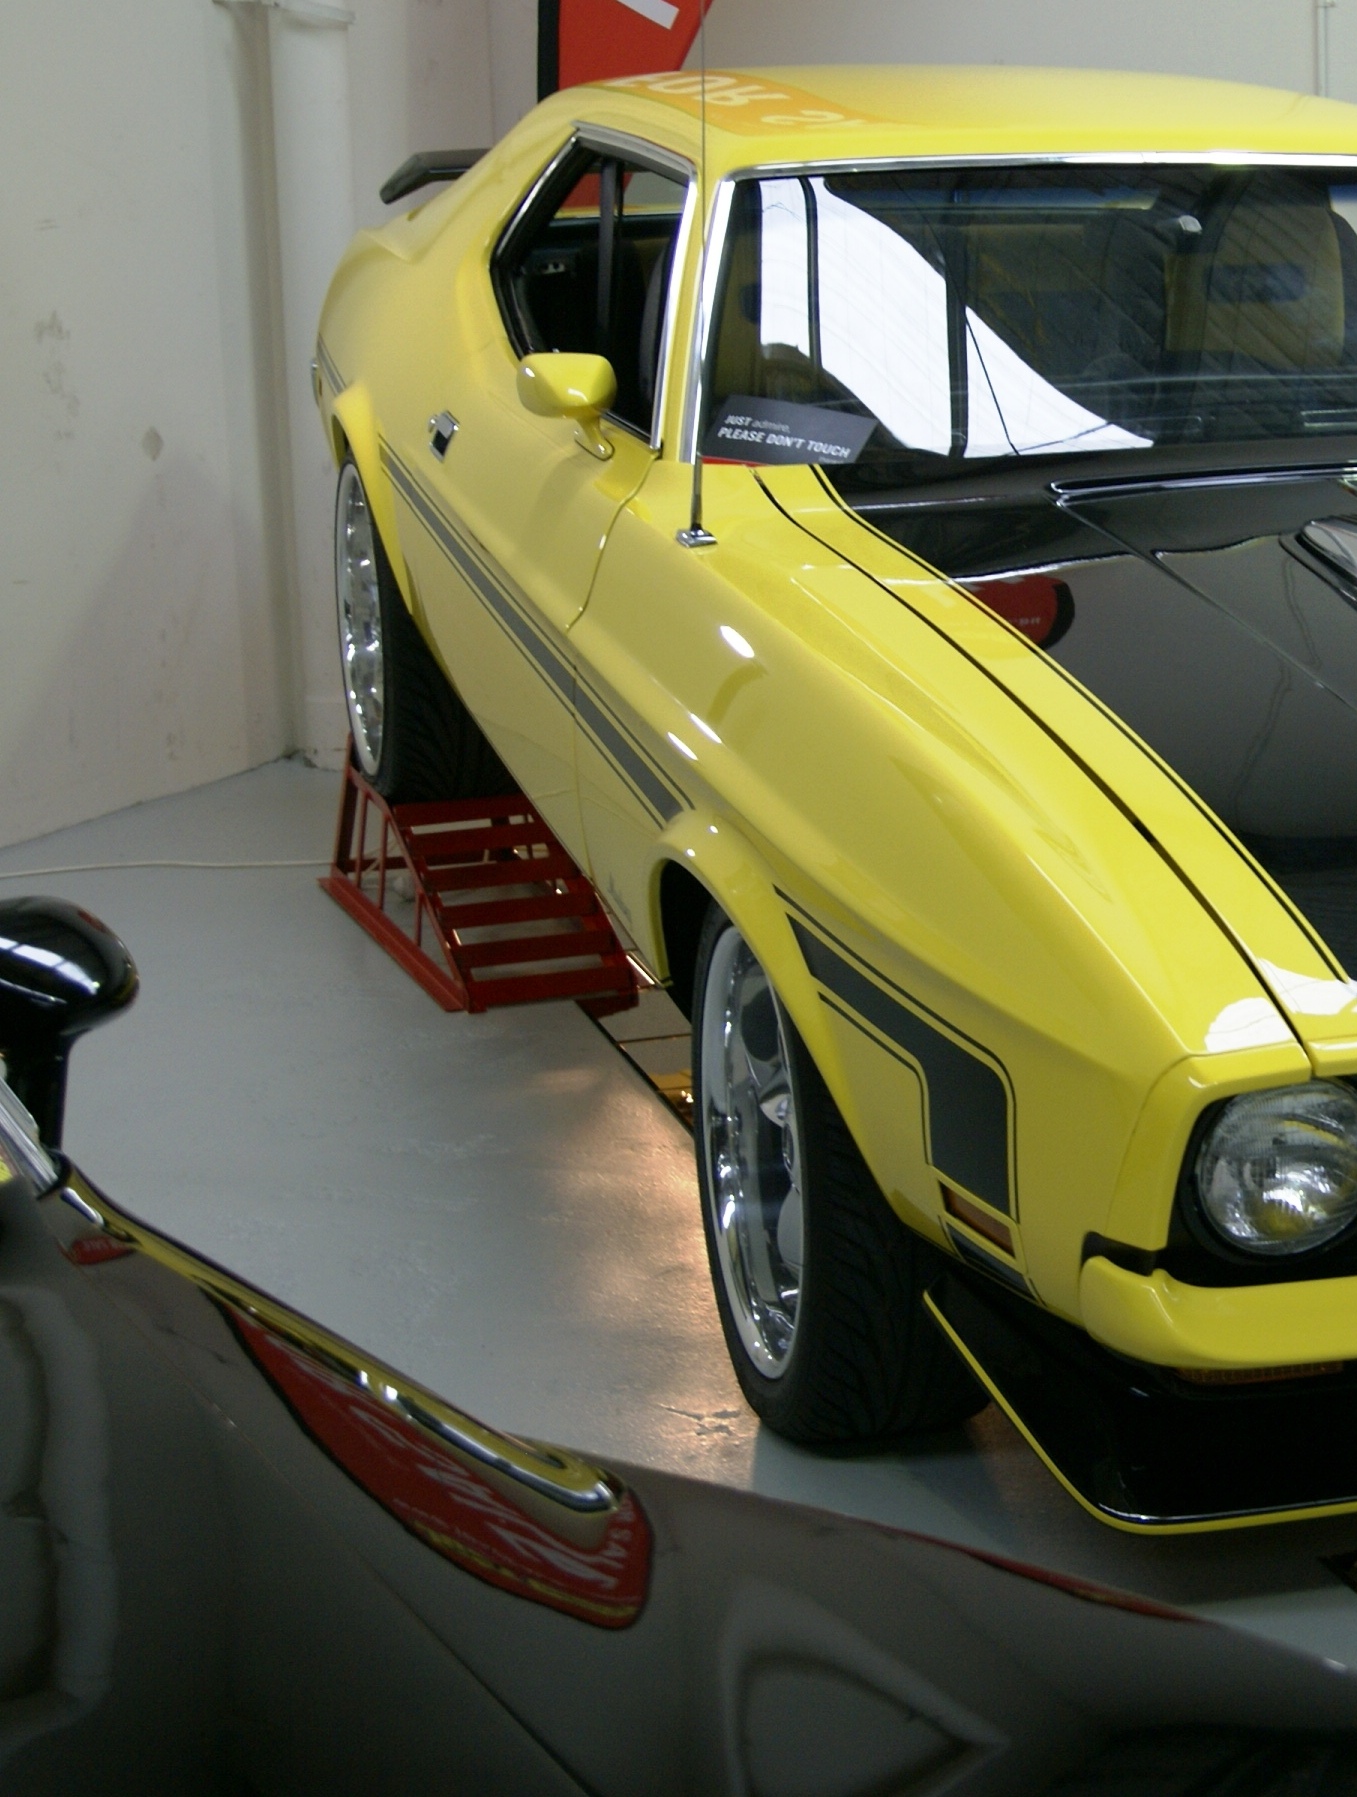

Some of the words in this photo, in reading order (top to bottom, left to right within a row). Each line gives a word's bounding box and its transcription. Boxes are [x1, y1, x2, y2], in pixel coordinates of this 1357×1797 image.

[724, 414, 753, 426] JUST
[718, 427, 765, 443] PLEASE
[766, 434, 804, 449] DON'T
[807, 440, 850, 457] TOUCH
